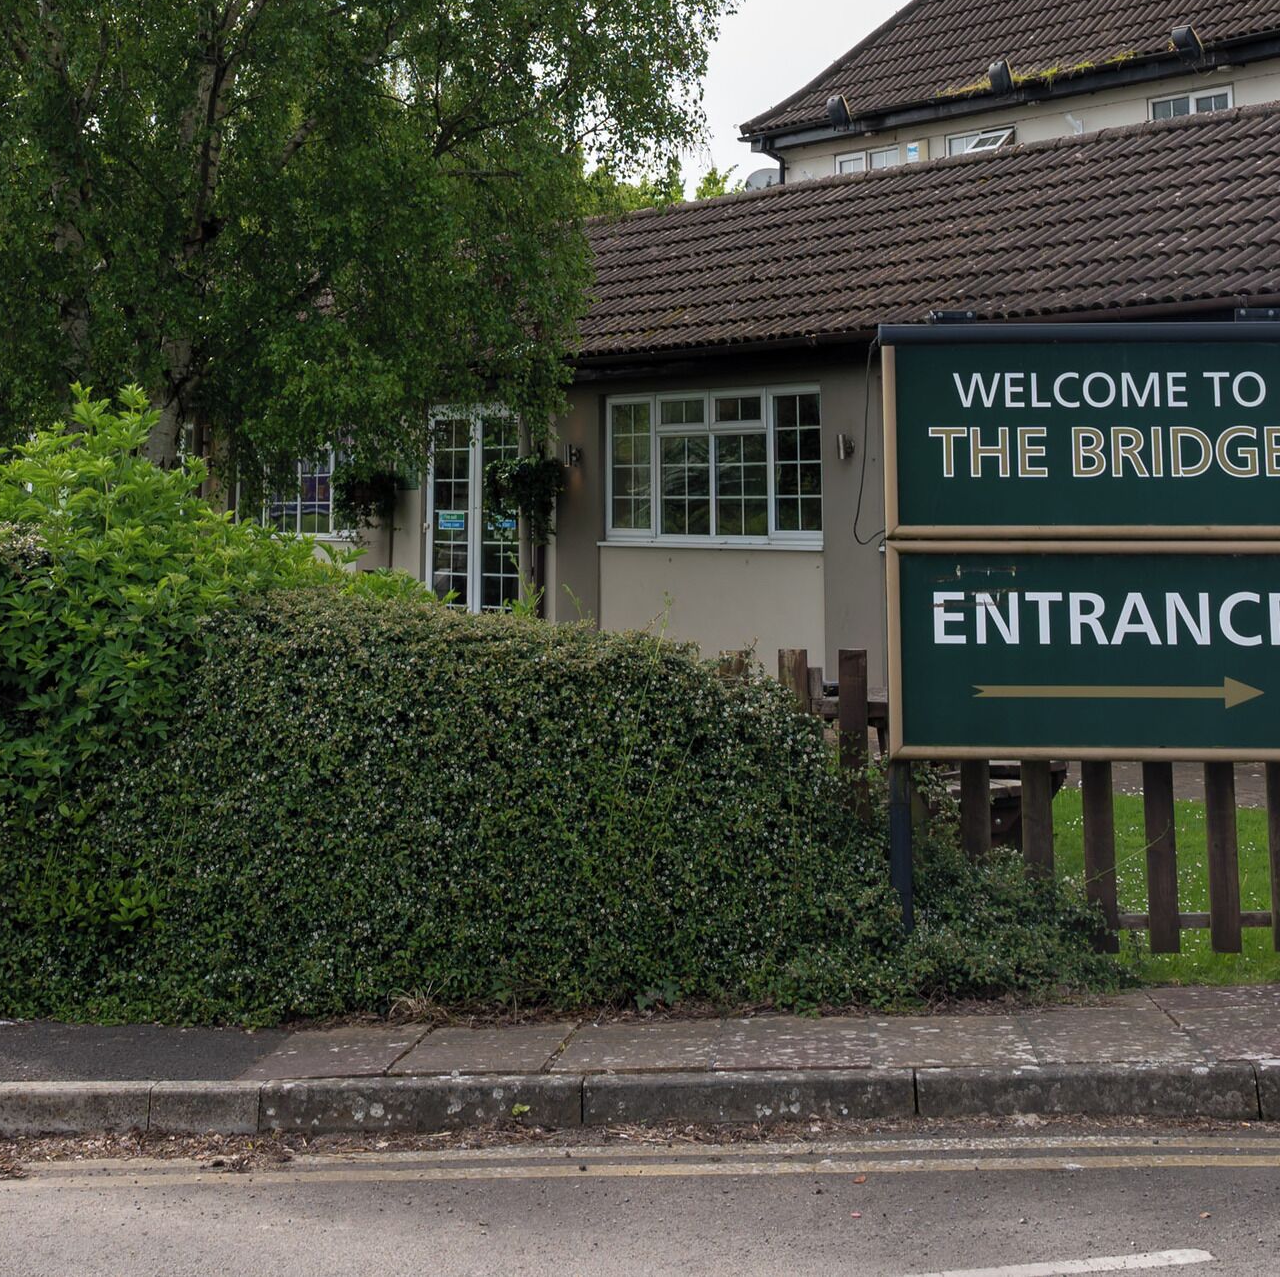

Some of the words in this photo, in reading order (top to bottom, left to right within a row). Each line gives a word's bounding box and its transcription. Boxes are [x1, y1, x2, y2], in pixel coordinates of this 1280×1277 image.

[953, 371, 1188, 408] WELCOME
[1203, 371, 1267, 408] TO
[928, 426, 1048, 478] THE
